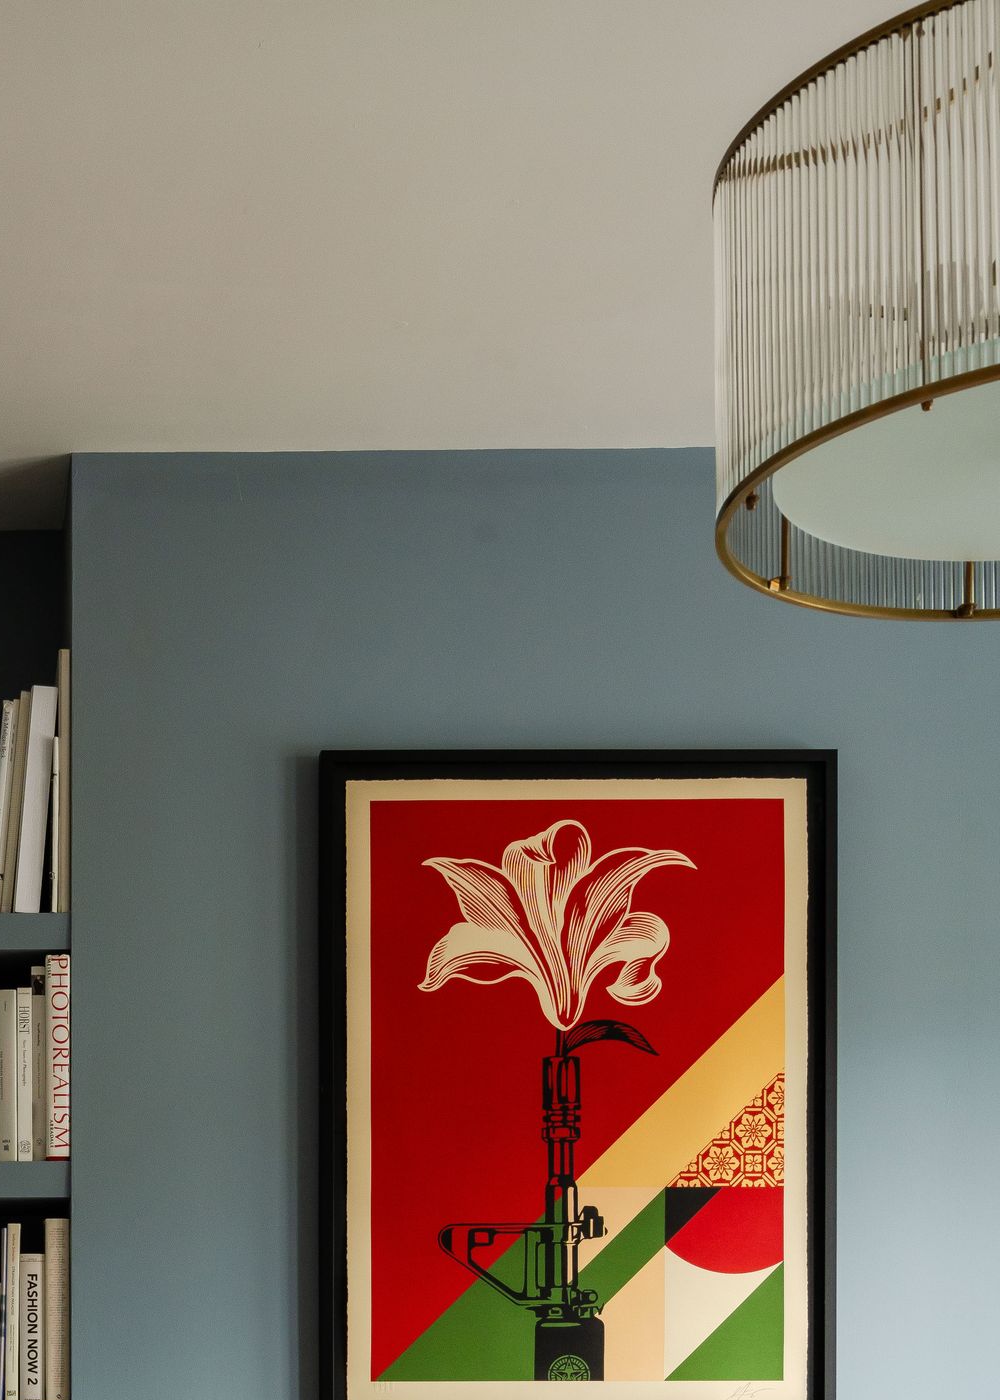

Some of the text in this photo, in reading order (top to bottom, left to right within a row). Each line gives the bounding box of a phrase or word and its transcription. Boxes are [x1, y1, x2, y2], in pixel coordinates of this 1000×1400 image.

[19, 1006, 30, 1034] HORST
[50, 957, 70, 1148] PHOTOREALISM
[26, 1273, 38, 1386] FASHION NOW 2
